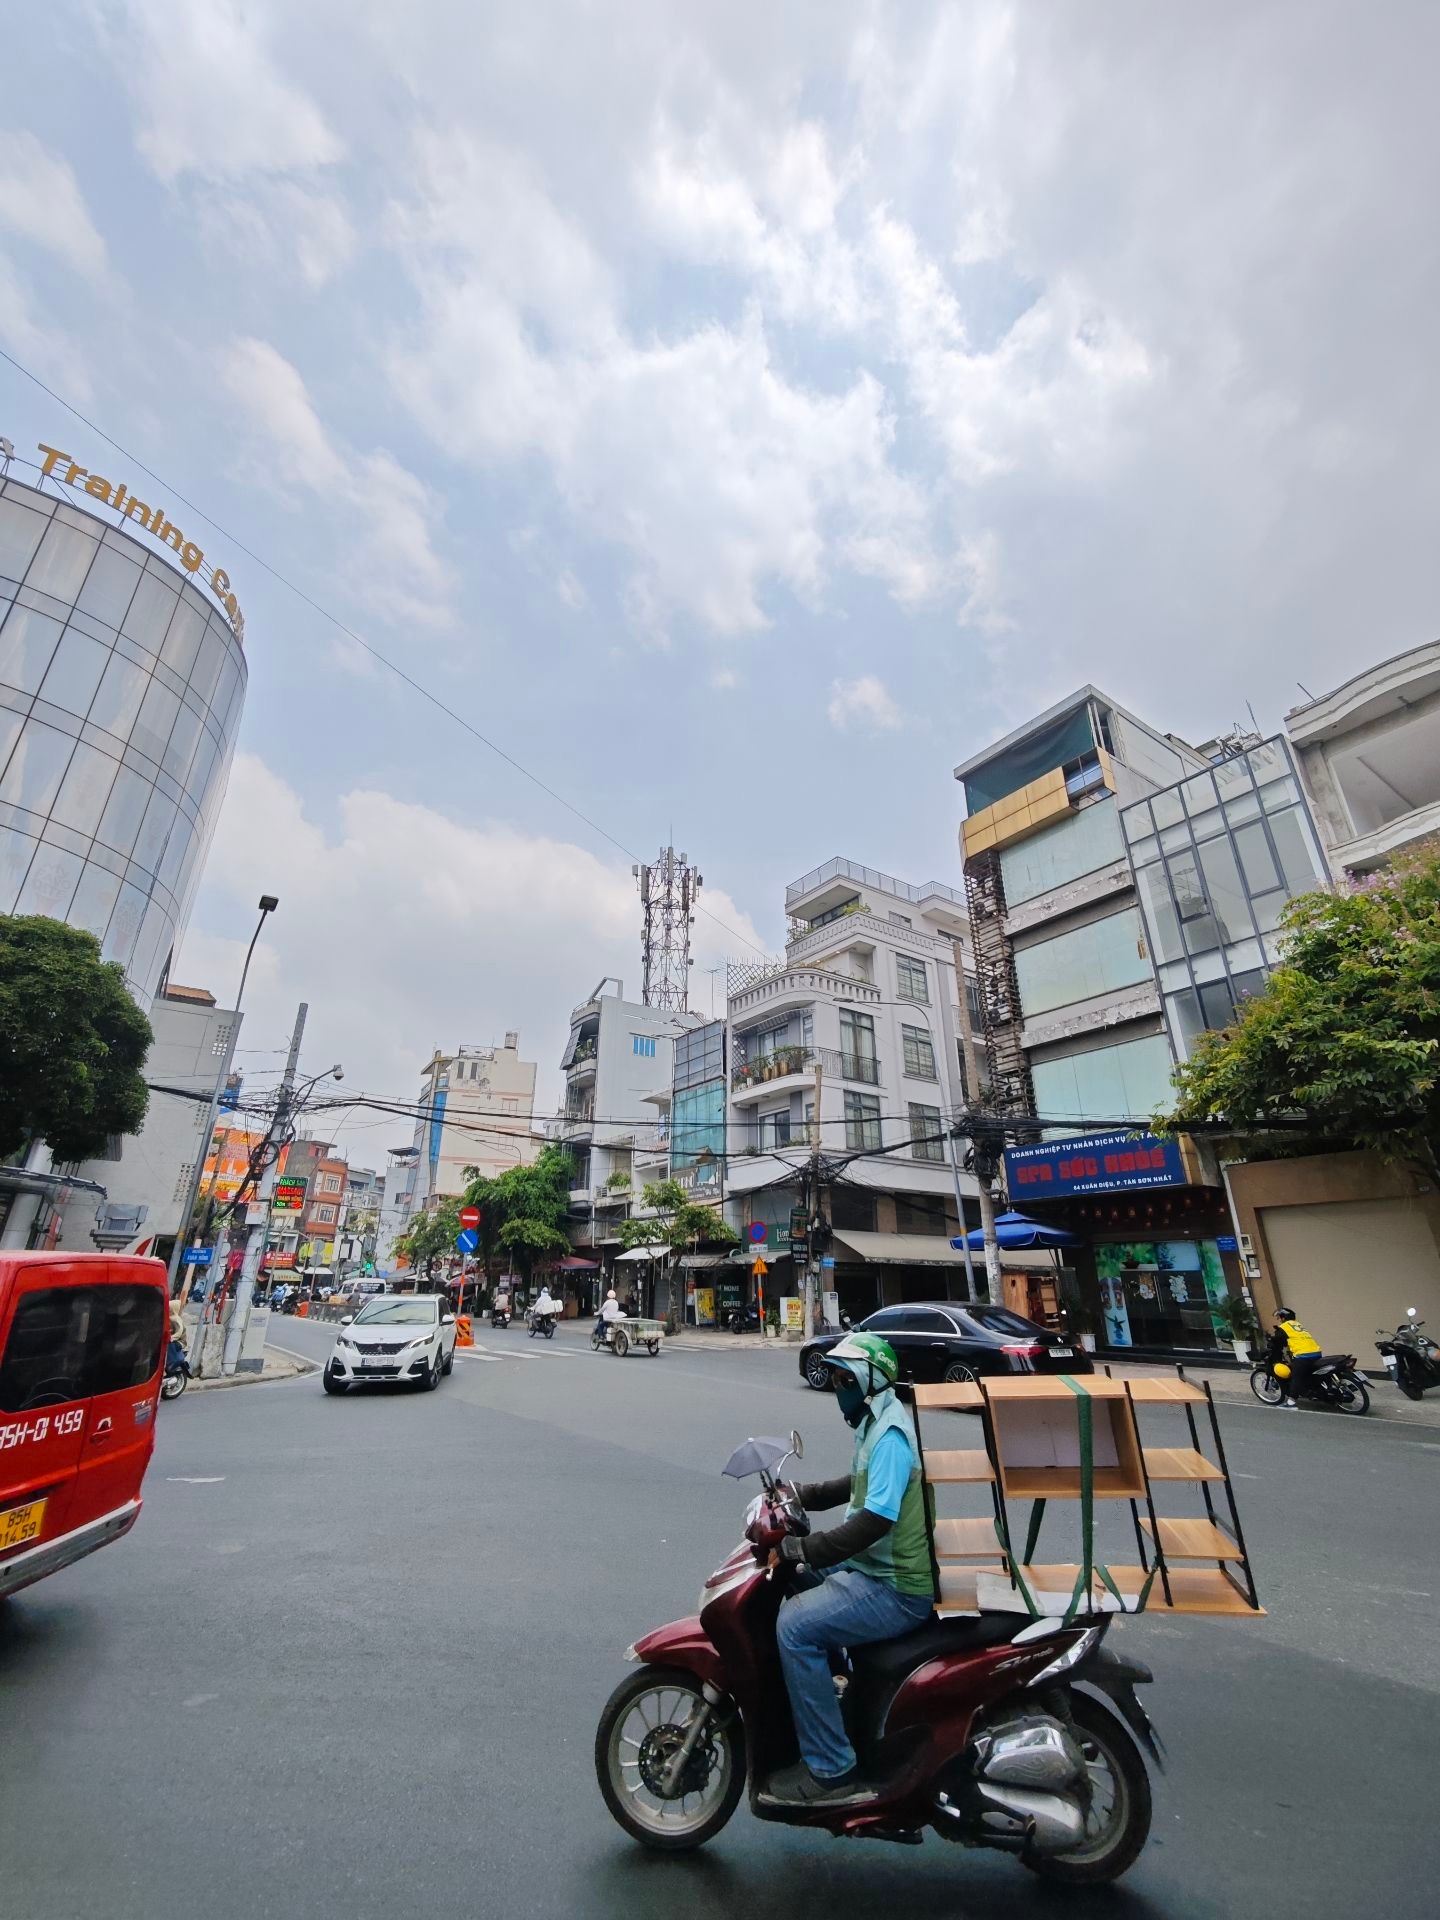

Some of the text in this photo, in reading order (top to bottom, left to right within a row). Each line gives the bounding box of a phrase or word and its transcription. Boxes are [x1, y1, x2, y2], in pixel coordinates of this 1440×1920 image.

[38, 443, 204, 572] Training
[1011, 1149, 1034, 1159] DOANH
[1062, 1143, 1072, 1151] TƯ
[1073, 1140, 1094, 1149] NHÂN
[1115, 1135, 1126, 1144] VỤ
[1017, 1163, 1052, 1184] SPA
[877, 1351, 897, 1371] Grab
